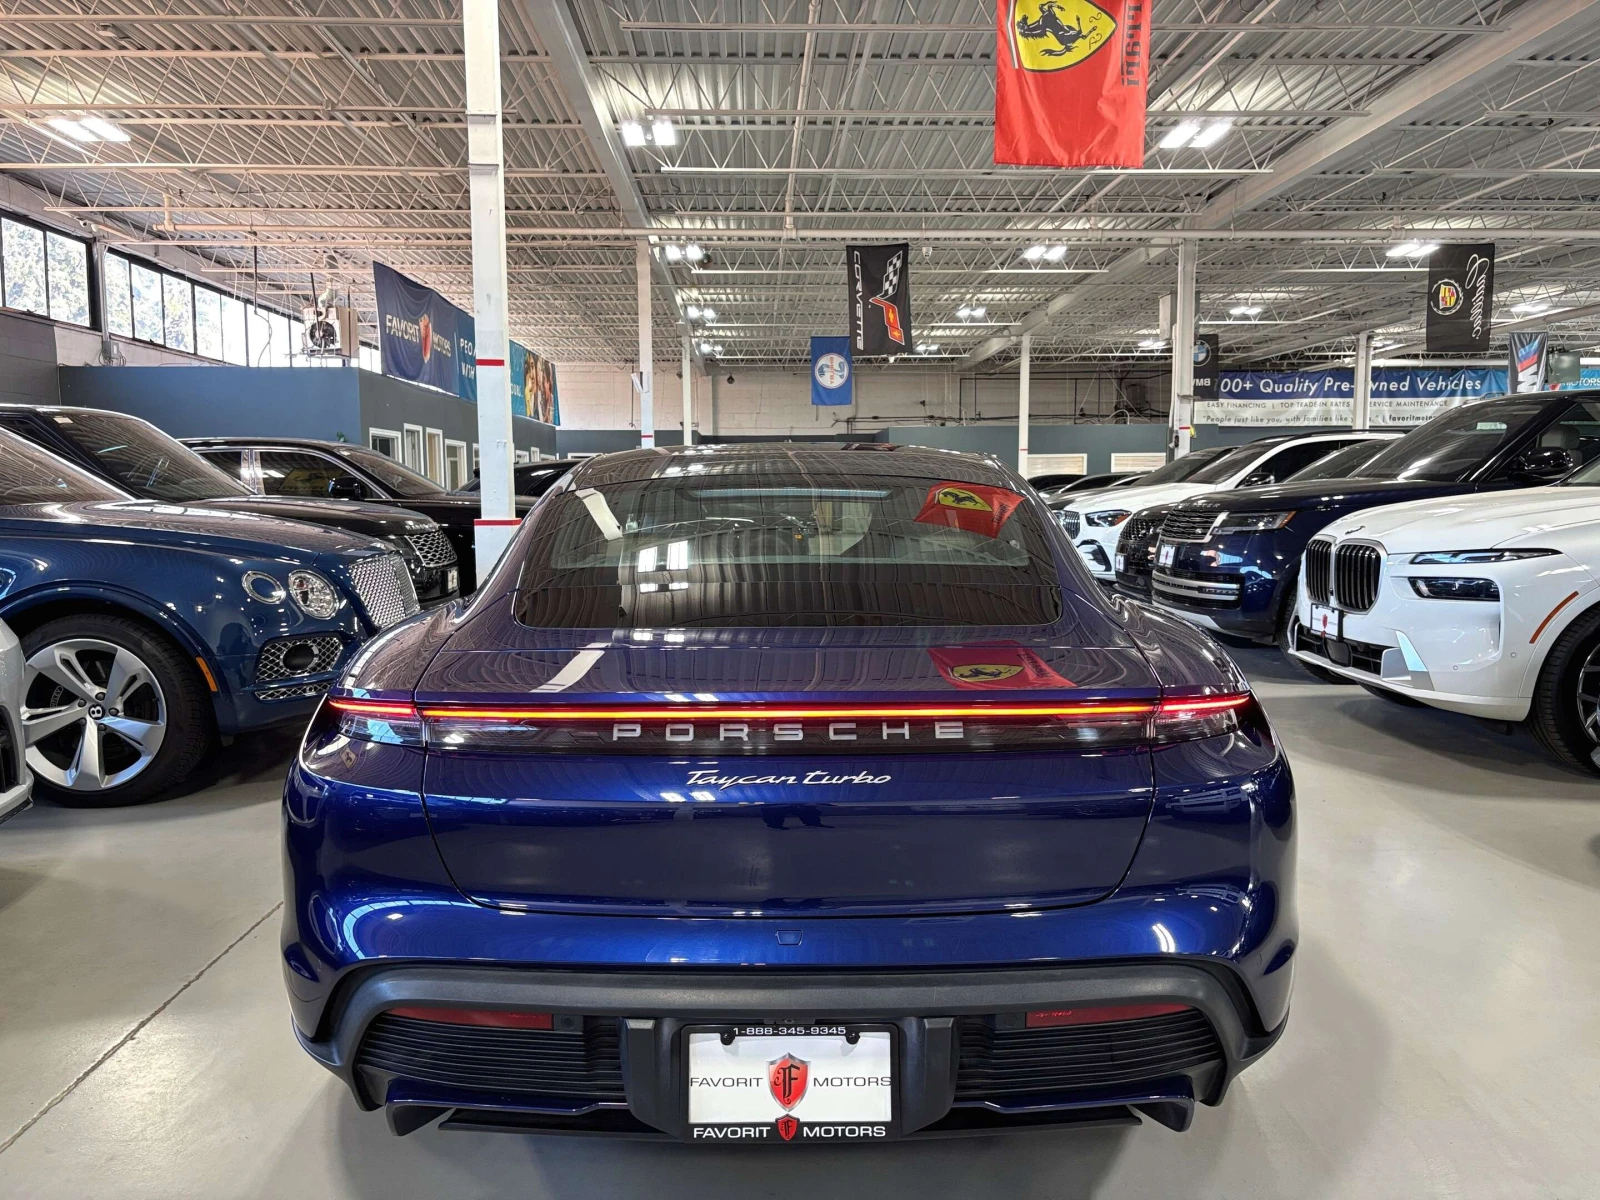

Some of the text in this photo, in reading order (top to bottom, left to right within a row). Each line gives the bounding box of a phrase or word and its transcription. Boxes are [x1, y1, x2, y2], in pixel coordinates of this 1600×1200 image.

[854, 250, 864, 351] CORVETTE
[386, 315, 420, 344] FAVORIT
[460, 338, 477, 357] PEO
[1259, 378, 1320, 396] Quality
[1416, 377, 1482, 392] Vehicles
[1234, 415, 1249, 424] just
[1250, 415, 1264, 423] like
[1334, 414, 1348, 422] like
[612, 721, 964, 742] PORSCHE
[685, 769, 892, 791] Taycan turbo
[733, 1026, 847, 1035] 1-888-345-9345
[690, 1077, 764, 1088] FAVORIT
[813, 1076, 892, 1088] MOTORS
[693, 1127, 771, 1138] FAVORIT
[802, 1126, 886, 1138] MOTORS
